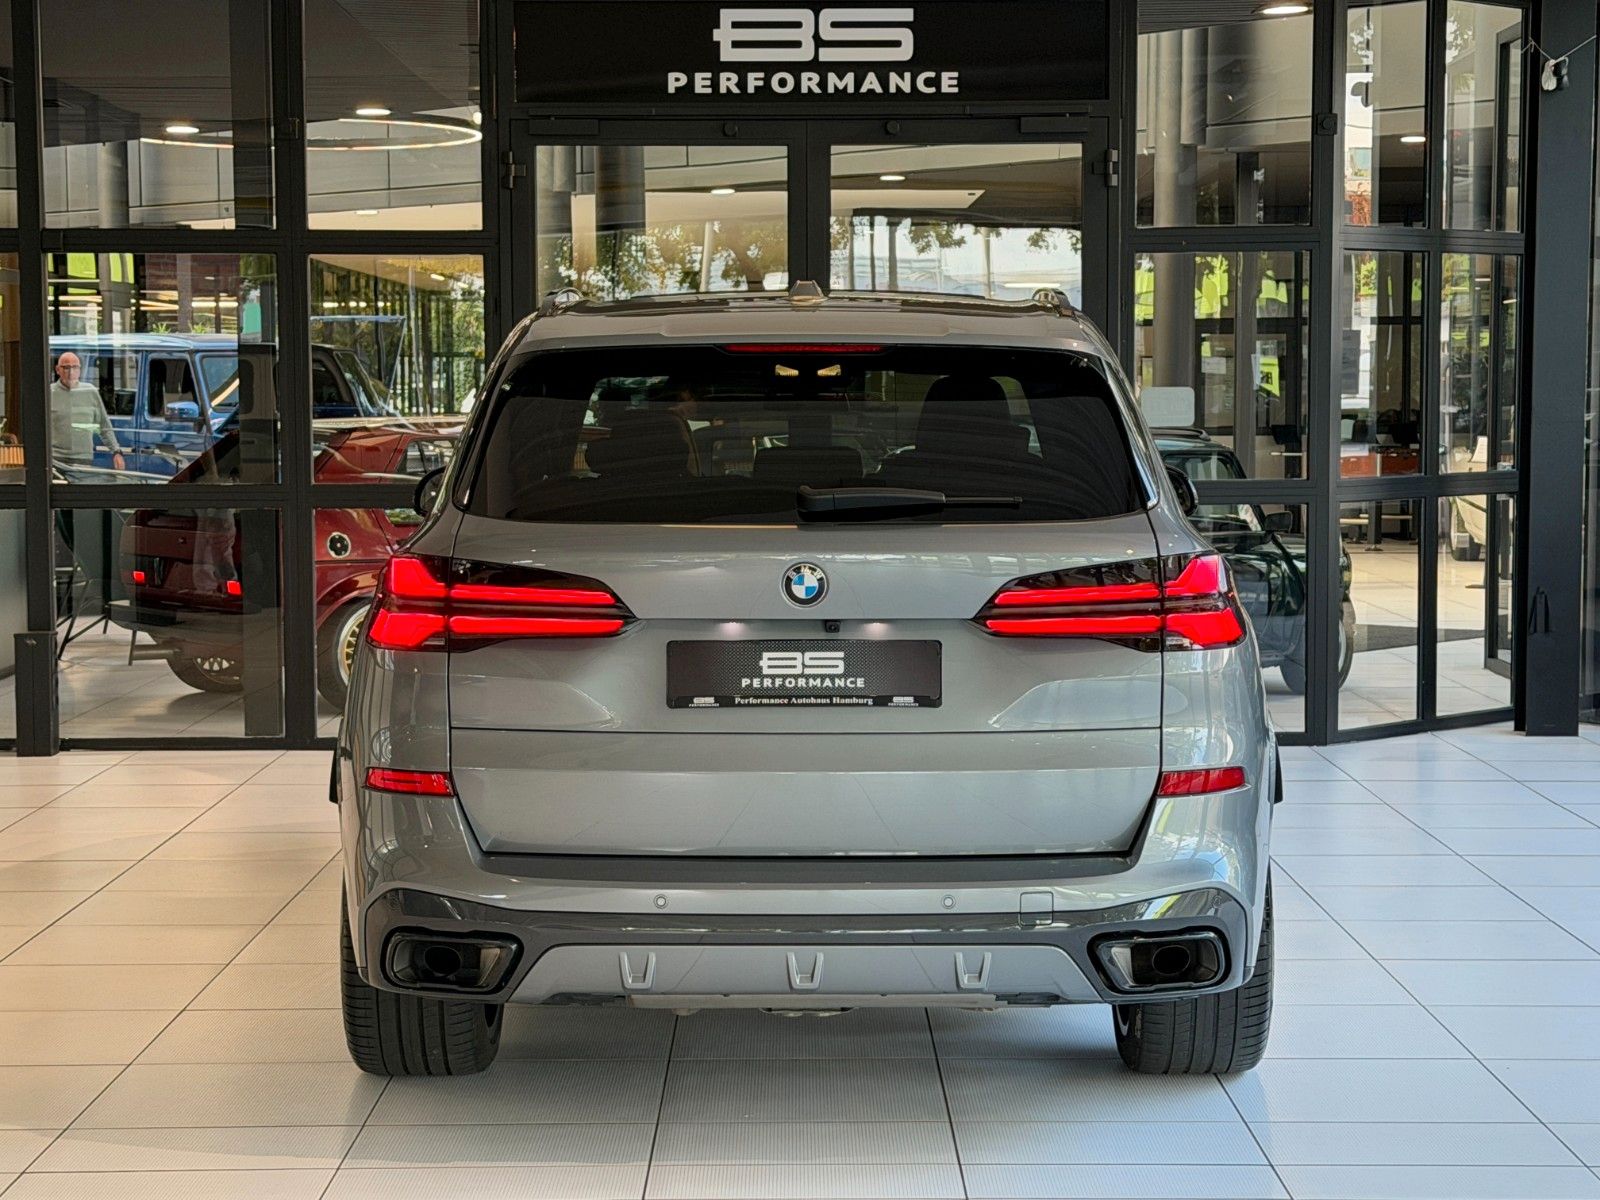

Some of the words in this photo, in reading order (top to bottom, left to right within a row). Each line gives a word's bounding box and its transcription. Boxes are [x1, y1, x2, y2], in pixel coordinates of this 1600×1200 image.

[713, 8, 914, 62] BS
[667, 71, 960, 94] PERFORMANCE
[759, 651, 845, 675] BS
[741, 677, 866, 688] PERFORMANCE
[734, 696, 789, 705] Performance
[790, 696, 831, 704] Autohaus
[832, 696, 874, 706] Hamburg
